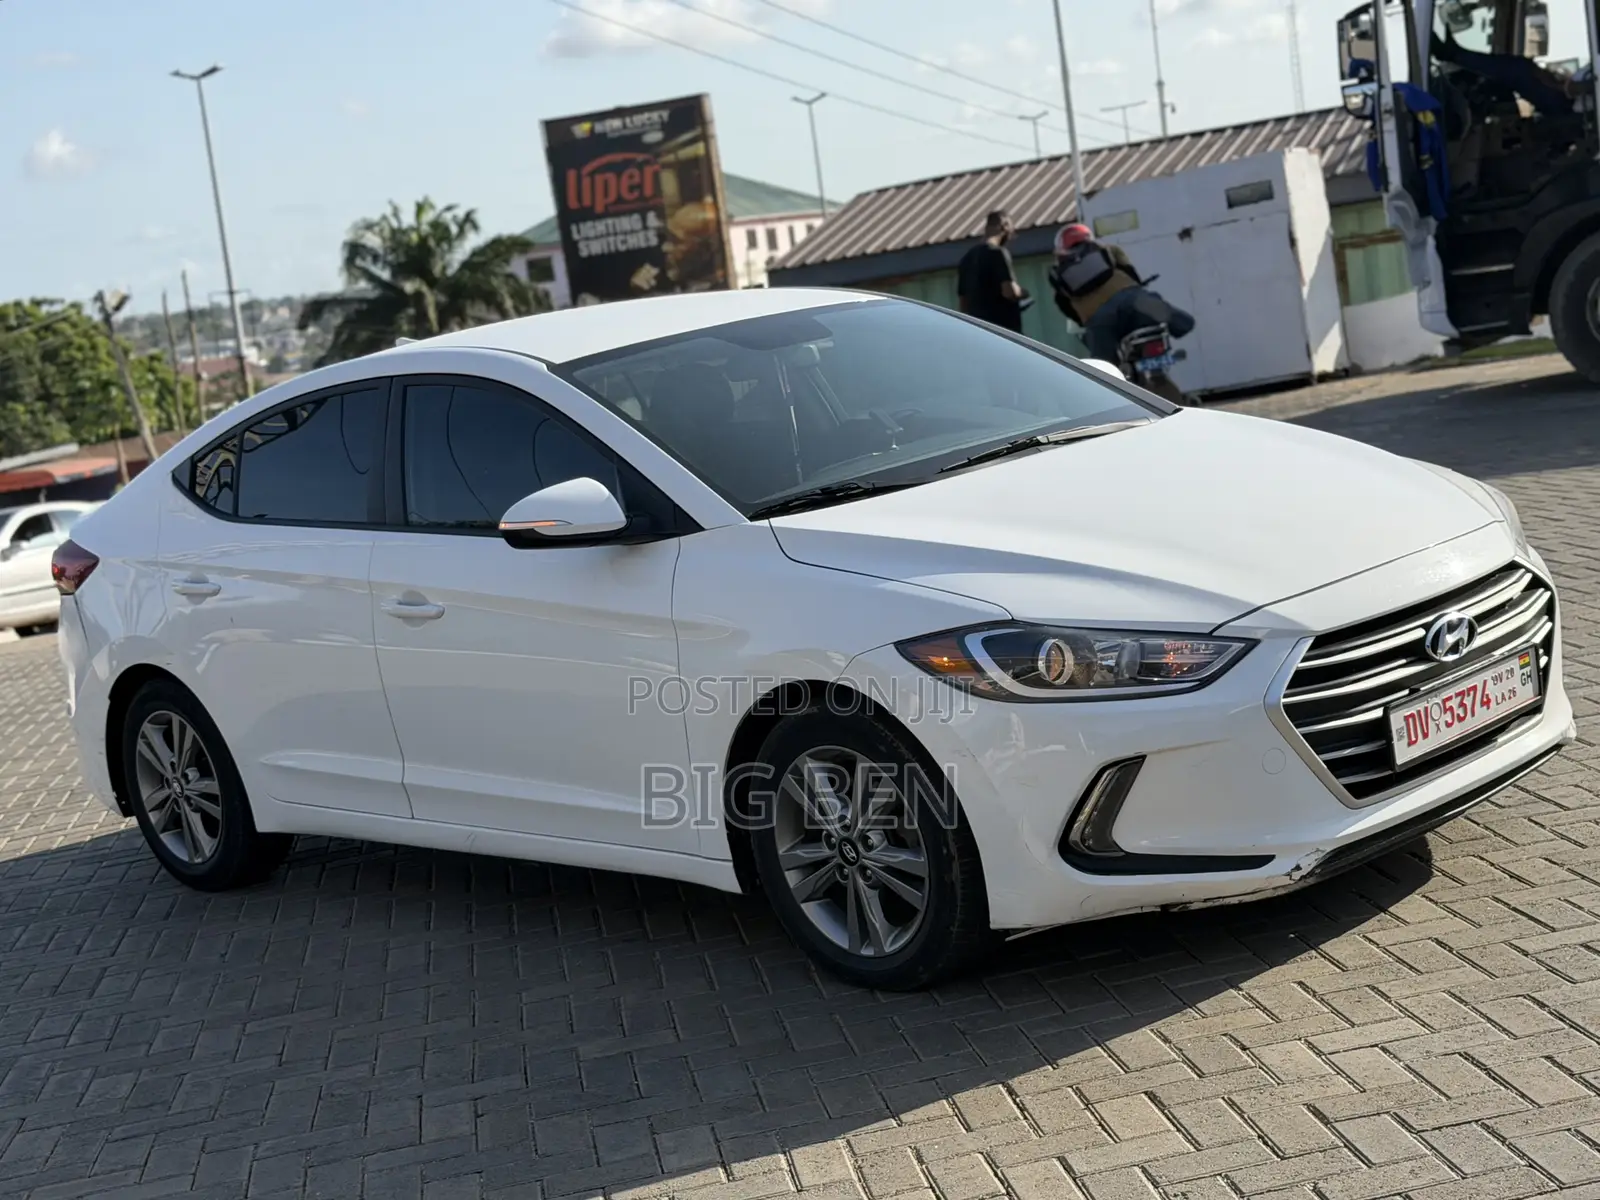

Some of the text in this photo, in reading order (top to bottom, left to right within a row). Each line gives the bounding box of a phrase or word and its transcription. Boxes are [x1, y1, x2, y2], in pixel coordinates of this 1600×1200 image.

[566, 161, 661, 214] liper
[571, 210, 664, 241] LIGHTING &
[578, 230, 659, 257] SWITCHES
[1520, 669, 1533, 687] GH
[1441, 679, 1492, 729] 5374
